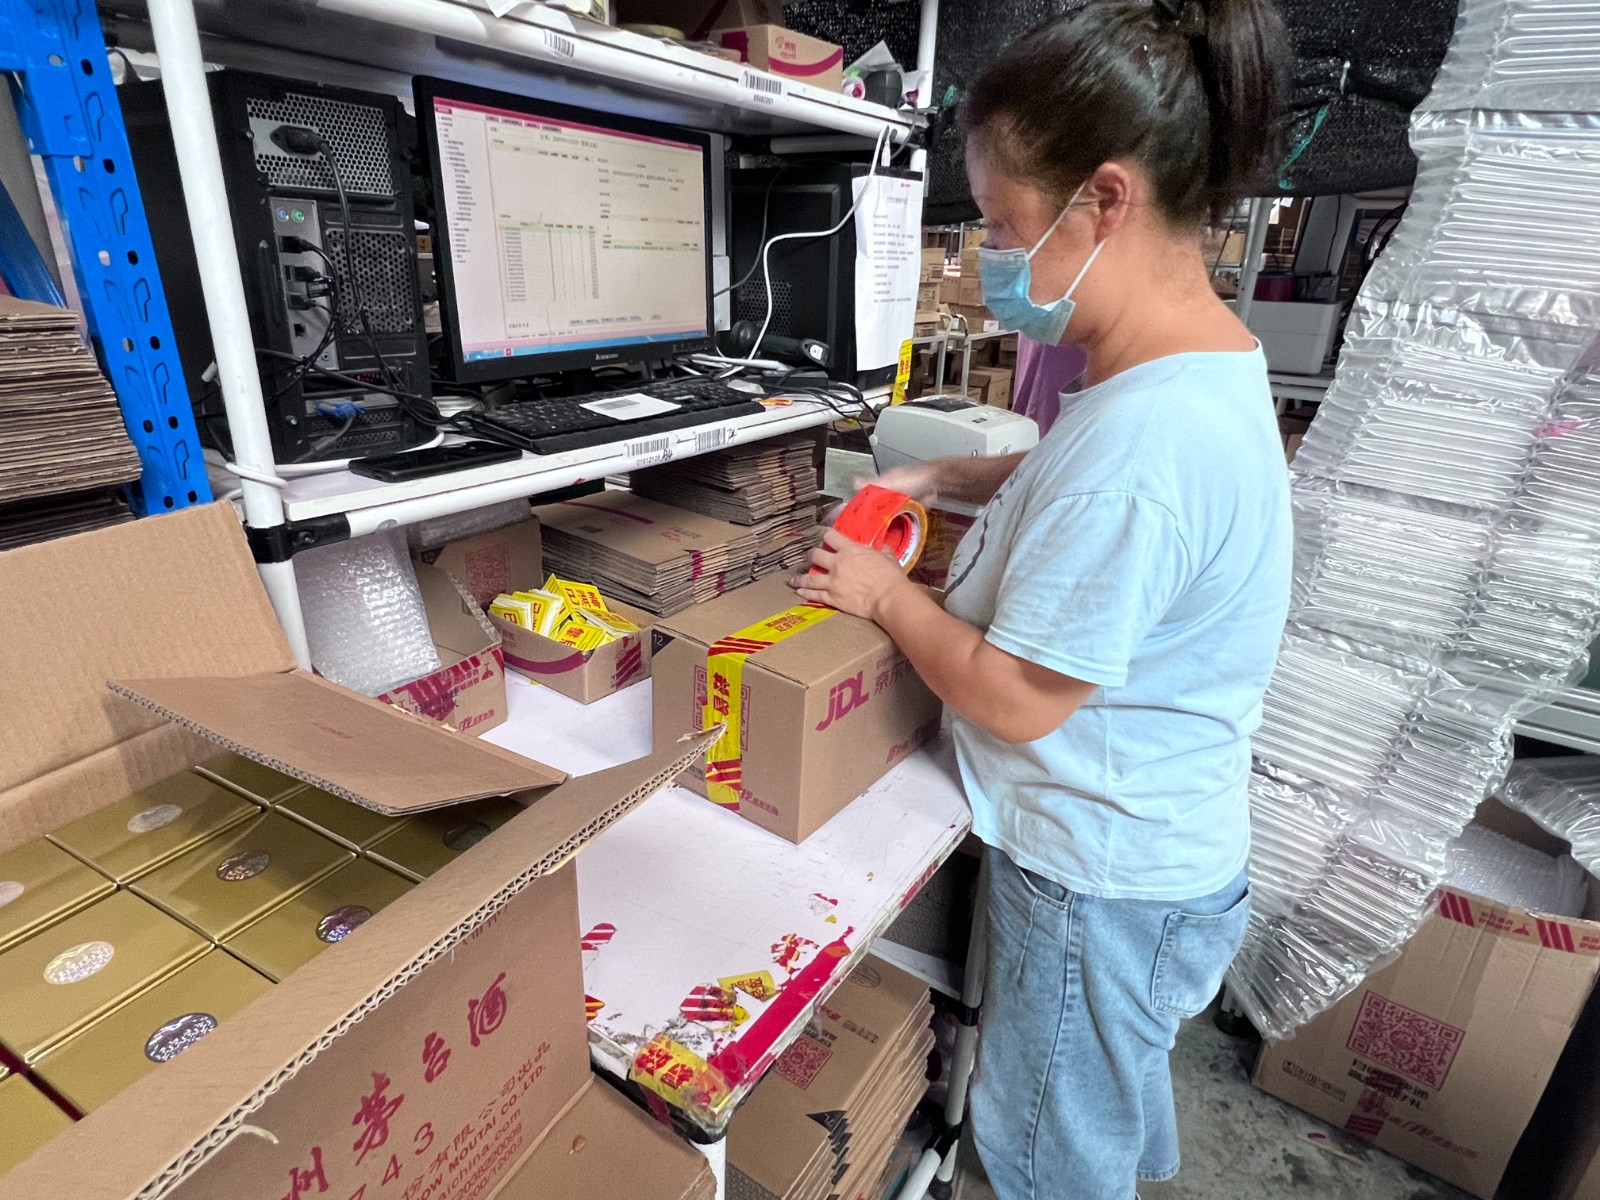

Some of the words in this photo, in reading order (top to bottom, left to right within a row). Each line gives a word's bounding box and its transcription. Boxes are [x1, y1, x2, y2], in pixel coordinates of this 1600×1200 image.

[653, 633, 664, 647] 12
[815, 670, 870, 731] JDL
[449, 1116, 497, 1174] MOUTAI
